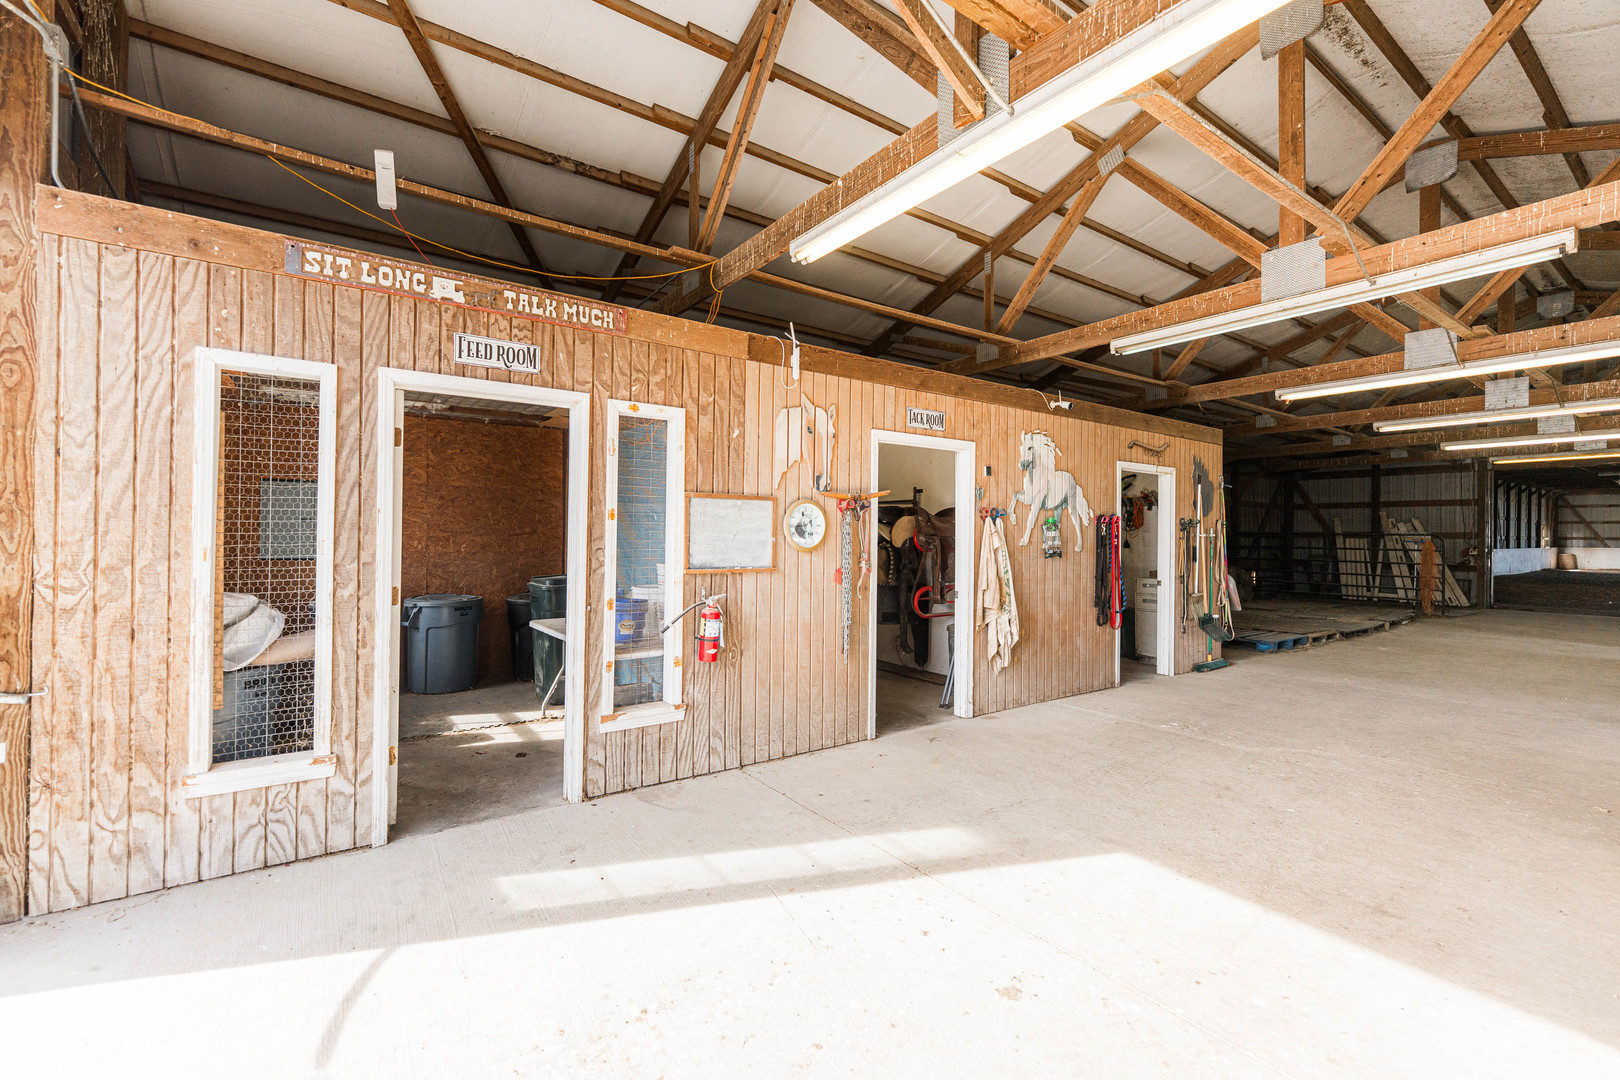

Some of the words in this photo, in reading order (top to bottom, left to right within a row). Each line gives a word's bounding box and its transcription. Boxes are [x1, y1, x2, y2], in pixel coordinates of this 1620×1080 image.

[304, 251, 351, 279] SIT
[361, 261, 426, 293] LONG
[503, 289, 557, 318] TALK
[563, 302, 614, 329] MUCH
[457, 335, 493, 361] FEED
[496, 344, 537, 369] ROOM
[908, 408, 925, 426] TACK
[925, 413, 944, 429] ROOM
